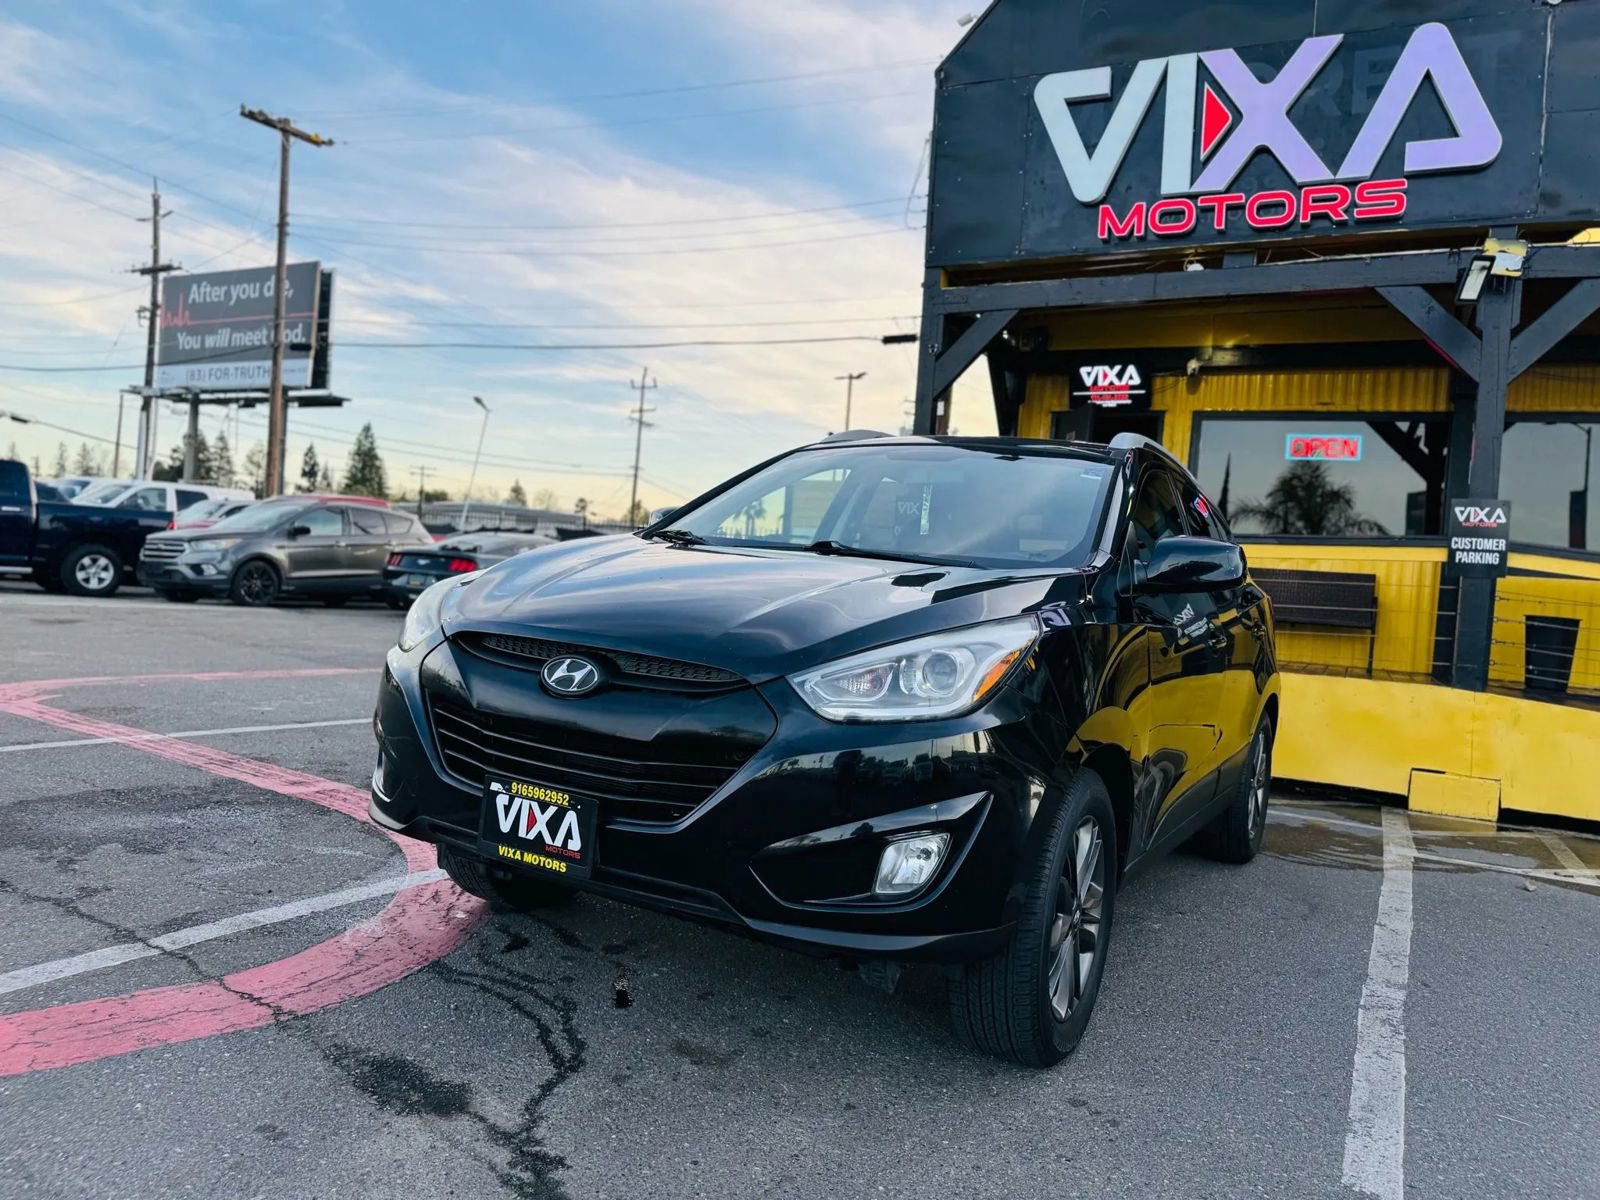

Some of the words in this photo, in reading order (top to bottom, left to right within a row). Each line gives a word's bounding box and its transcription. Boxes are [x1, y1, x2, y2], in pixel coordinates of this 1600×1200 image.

[1034, 22, 1502, 204] VIXA
[1097, 178, 1408, 240] MOTORS
[188, 281, 227, 304] After
[229, 281, 260, 306] you
[263, 274, 294, 299] de,
[177, 331, 200, 350] You
[204, 328, 230, 349] will
[231, 325, 268, 346] meet
[270, 322, 306, 345] od.
[1079, 364, 1141, 387] VIXA
[1291, 437, 1358, 458] OPEN
[1454, 506, 1507, 523] VIXA
[1451, 537, 1506, 551] CUSTOMER
[1455, 551, 1499, 565] PARKING
[511, 782, 570, 806] 9165962952
[495, 793, 582, 852] VIXA
[498, 845, 521, 860] VIXA
[523, 852, 567, 873] MOTORS
[545, 845, 581, 859] MOTORS
